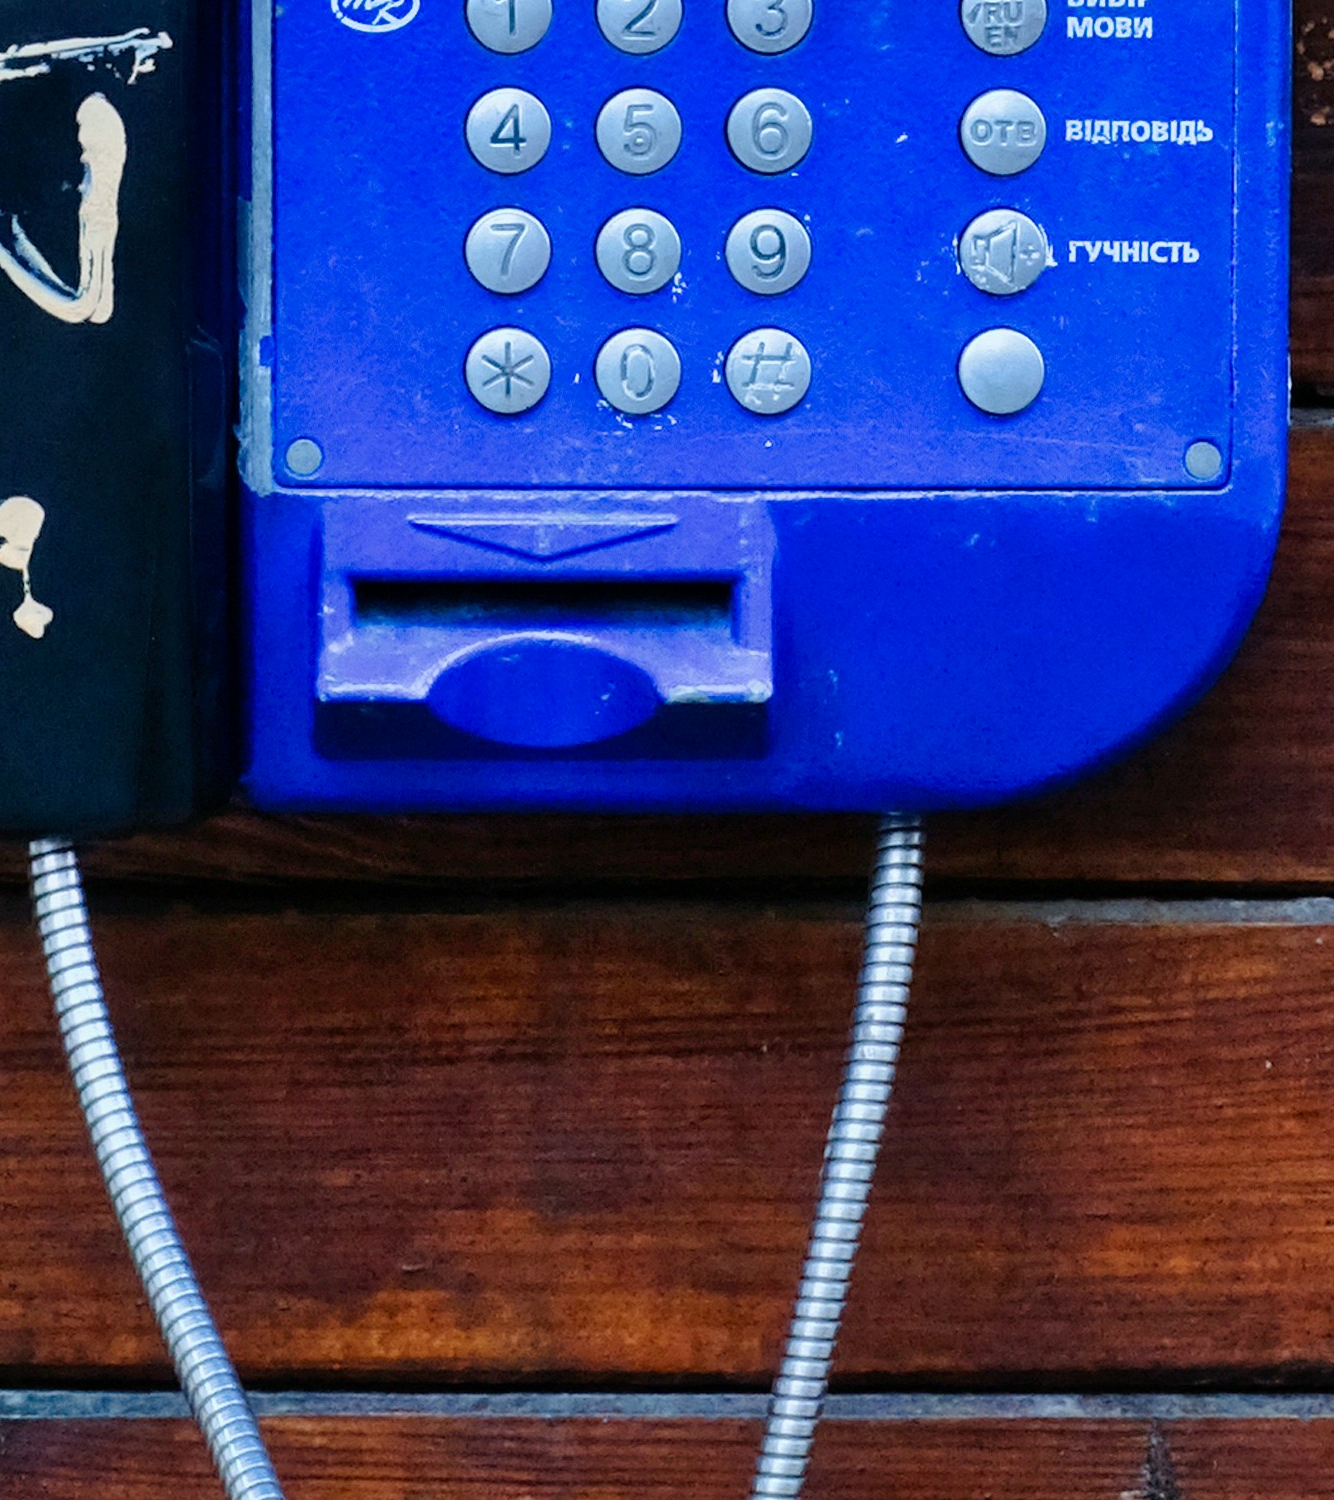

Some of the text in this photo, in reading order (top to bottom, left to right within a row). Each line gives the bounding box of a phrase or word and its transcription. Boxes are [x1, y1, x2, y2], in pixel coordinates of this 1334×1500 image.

[1067, 16, 1153, 39] МОВИ
[489, 103, 528, 157] 4
[623, 103, 658, 157] 5
[752, 101, 789, 160] 6
[1065, 118, 1214, 146] ВІДПОВІДЬ
[489, 222, 530, 277] 7
[622, 222, 657, 279] 8
[748, 223, 788, 279] 9
[1068, 239, 1201, 264] ГУЧНІСТЬ
[619, 343, 657, 401] 0
